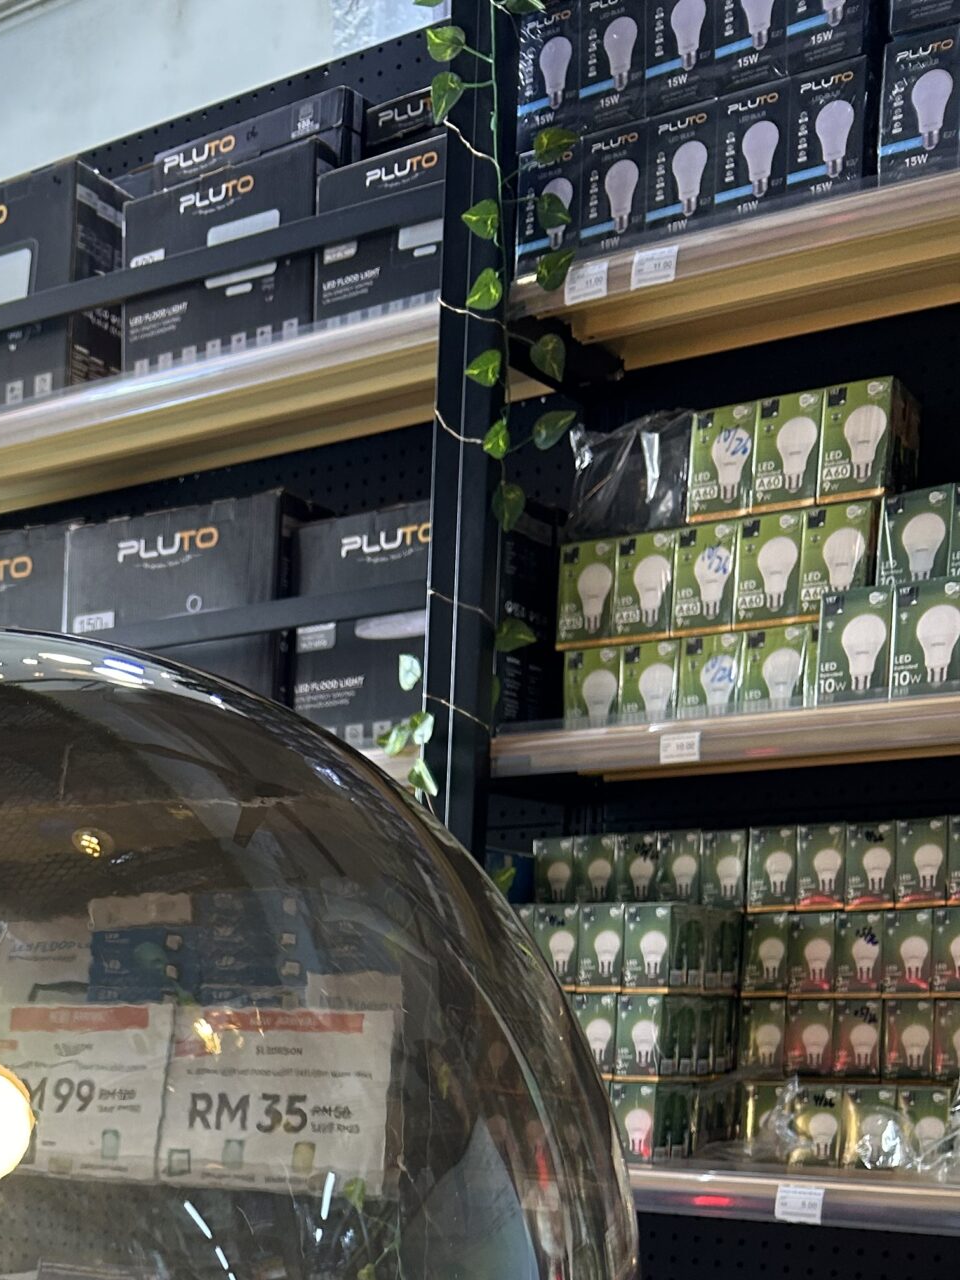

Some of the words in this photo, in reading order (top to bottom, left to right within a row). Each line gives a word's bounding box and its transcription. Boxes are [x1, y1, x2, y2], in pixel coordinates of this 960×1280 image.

[526, 9, 572, 32] PLUTO
[811, 30, 834, 46] 15W
[896, 39, 954, 63] PLUTO
[736, 53, 759, 68] 15W
[667, 73, 688, 88] 15W
[800, 71, 854, 94] PLUTO
[600, 94, 620, 109] 15W
[727, 92, 779, 115] PLUTO
[378, 97, 432, 127] PLUT
[658, 112, 708, 135] PLUTO
[592, 132, 639, 153] PLUTO
[164, 135, 235, 175] PLUTO
[905, 154, 929, 168] 15W
[364, 151, 438, 188] PLUTO
[179, 174, 254, 215] PLUTO
[810, 181, 833, 195] 15W
[825, 450, 843, 461] LED
[758, 461, 775, 472] LED
[824, 466, 848, 479] A60
[694, 472, 710, 482] LED
[757, 477, 782, 490] A60
[117, 526, 219, 563] PLUTO
[341, 522, 432, 559] PLUTO
[804, 571, 821, 582] LED
[740, 579, 756, 590] LED
[821, 662, 837, 672] LED
[895, 654, 912, 665] LED
[745, 690, 761, 700] LED
[53, 1076, 96, 1114] 99
[189, 1093, 251, 1131] RM
[256, 1093, 309, 1135] 35
